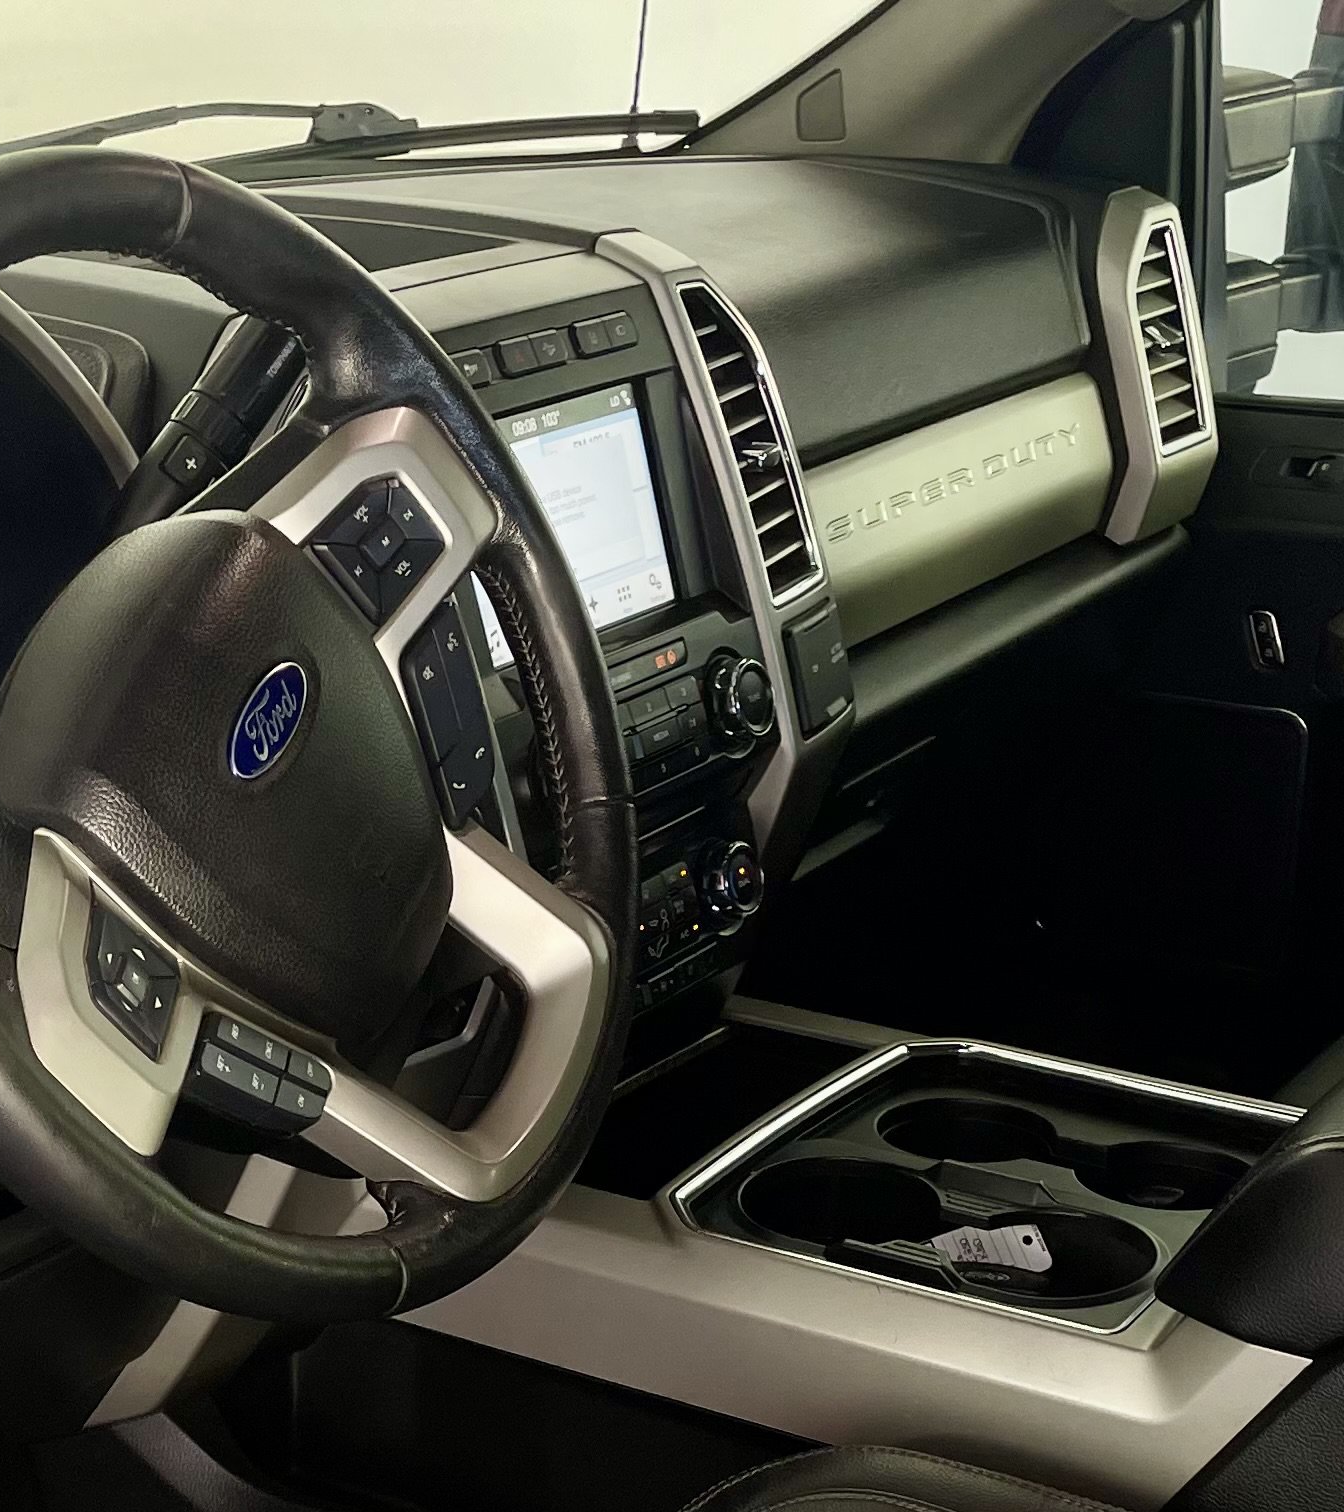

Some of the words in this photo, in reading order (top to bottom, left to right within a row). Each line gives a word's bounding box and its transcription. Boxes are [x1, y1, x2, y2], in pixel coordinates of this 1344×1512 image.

[825, 466, 975, 545] SUPER
[981, 423, 1080, 481] DUTY
[353, 504, 369, 521] VOL
[394, 560, 411, 577] VOL
[244, 679, 297, 762] Ford
